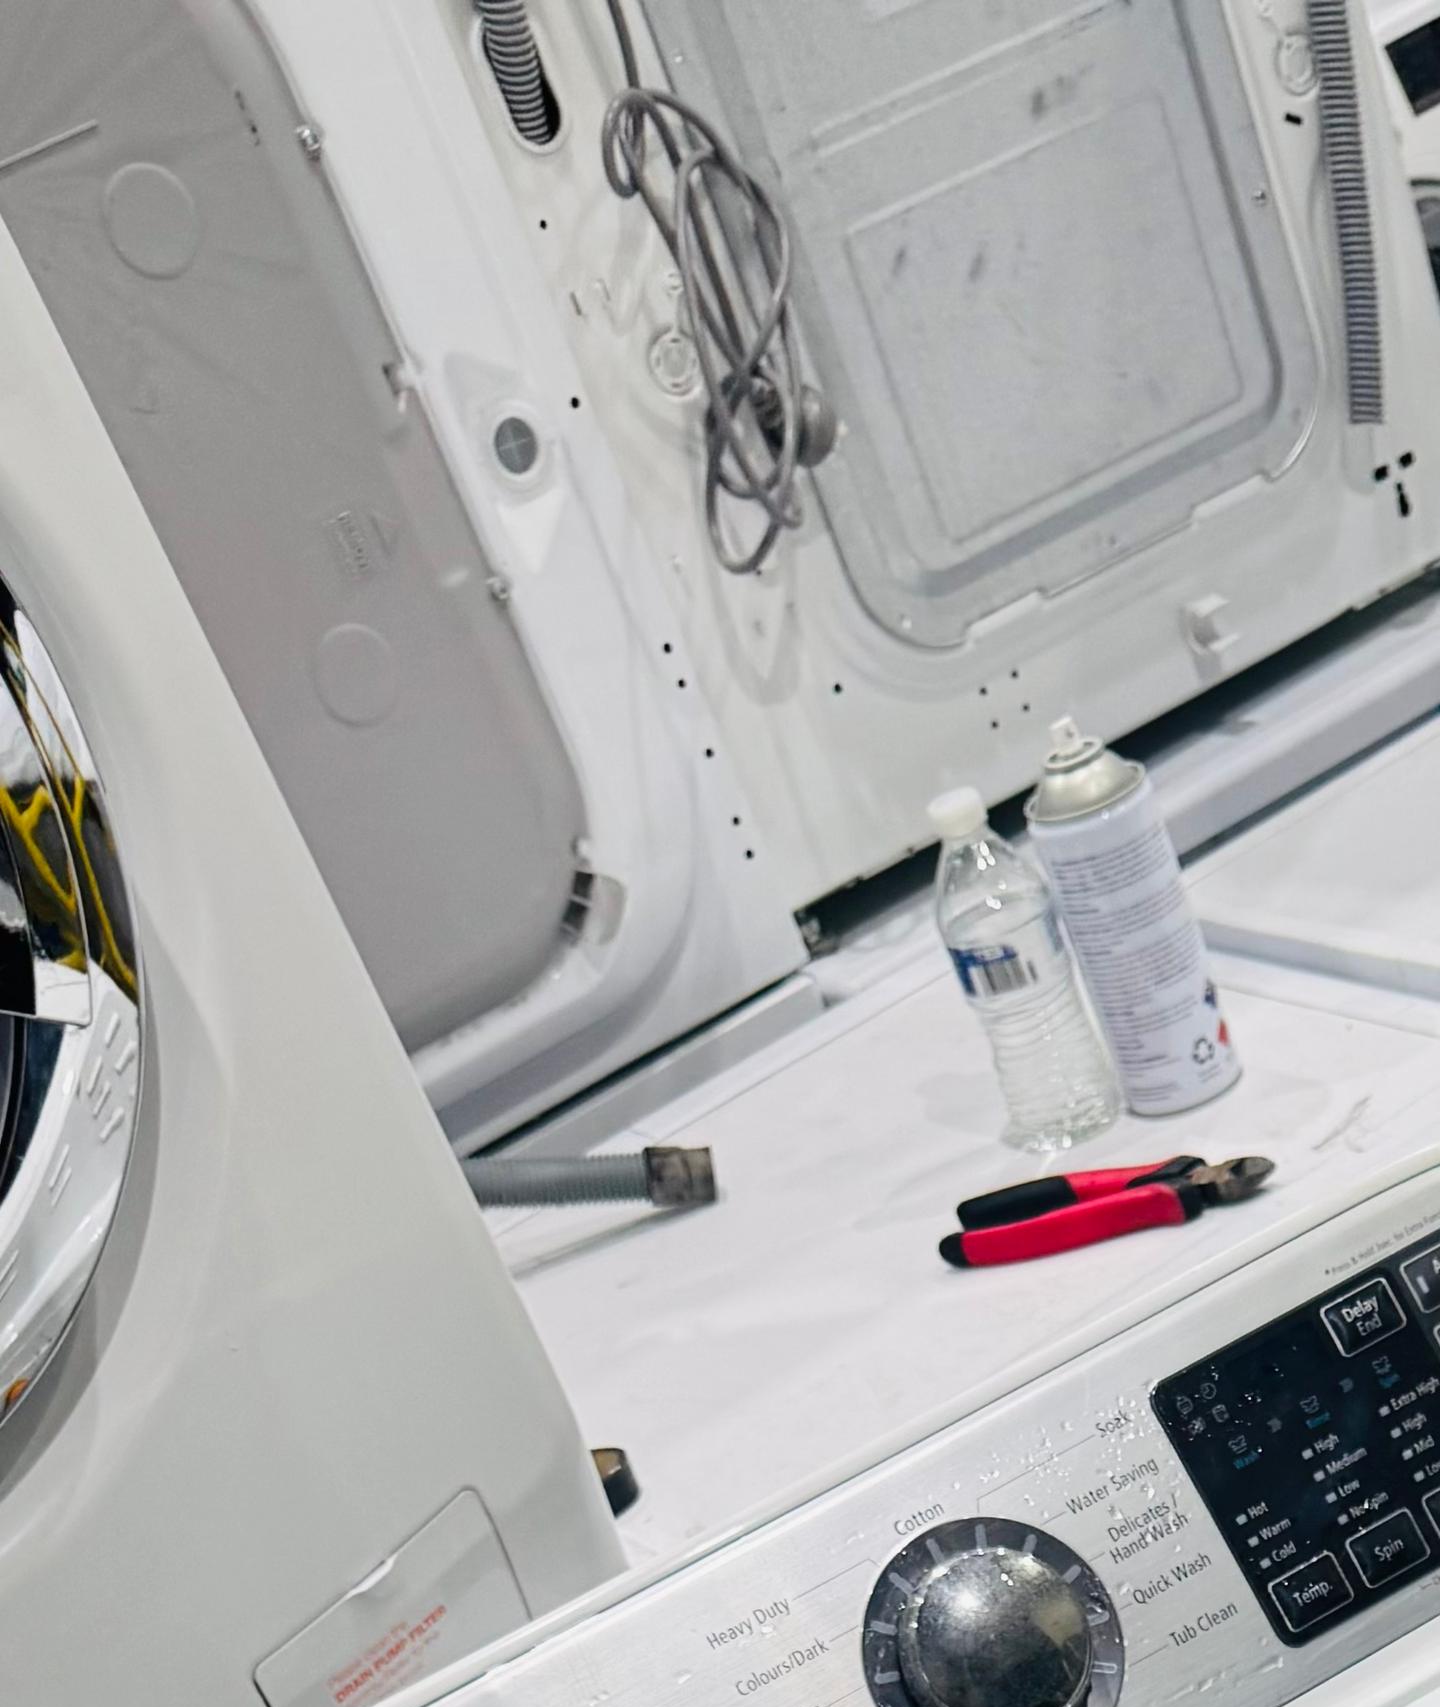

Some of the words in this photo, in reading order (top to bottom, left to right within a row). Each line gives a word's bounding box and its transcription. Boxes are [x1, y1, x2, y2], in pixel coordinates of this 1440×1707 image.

[1341, 1295, 1379, 1323] Delay
[1356, 1312, 1382, 1336] End
[1390, 1390, 1418, 1411] Extra
[1415, 1375, 1440, 1397] High
[1095, 1409, 1133, 1439] Soak
[1401, 1411, 1428, 1434] High
[1313, 1432, 1340, 1454] High
[1413, 1434, 1436, 1455] Mid
[1325, 1447, 1368, 1475] Medium
[1066, 1481, 1110, 1516] Water
[1107, 1457, 1161, 1494] Saving
[1337, 1479, 1361, 1498] Low
[893, 1502, 946, 1538] Cotton
[1106, 1502, 1171, 1544] Delicates
[1247, 1501, 1269, 1520] Hot
[1109, 1531, 1150, 1566] Hand
[1145, 1511, 1191, 1548] Wash
[1259, 1518, 1292, 1541] Warm
[1271, 1540, 1297, 1562] Cold
[1374, 1539, 1404, 1562] Spin
[1132, 1572, 1173, 1607] Quick
[1168, 1552, 1213, 1589] Wash
[1293, 1580, 1334, 1607] Temp.
[705, 1616, 752, 1651] Heavy
[751, 1597, 793, 1633] Duty
[1168, 1619, 1198, 1650] Tub
[1196, 1601, 1240, 1637] Clean
[734, 1637, 832, 1698] Colours/Dark
